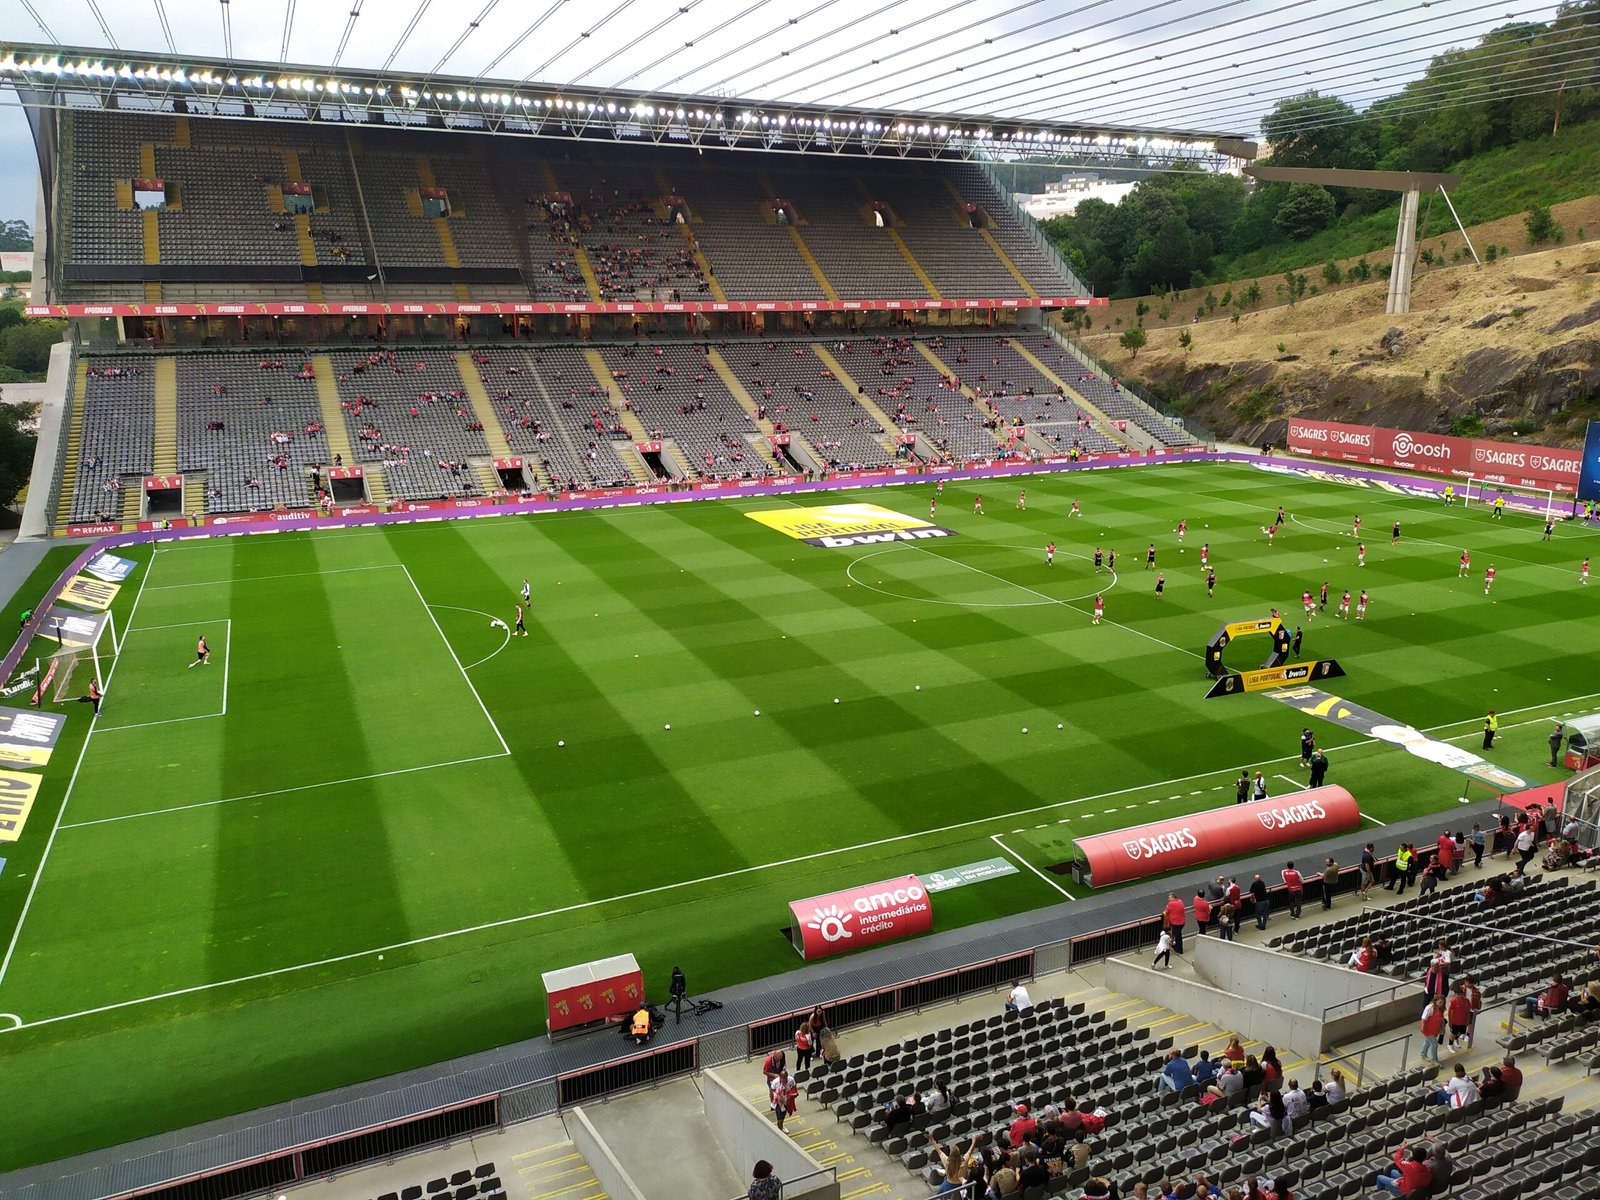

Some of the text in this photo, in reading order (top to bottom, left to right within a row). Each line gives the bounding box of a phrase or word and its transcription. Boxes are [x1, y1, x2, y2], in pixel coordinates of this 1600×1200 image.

[1298, 426, 1327, 442] SAGRES
[1339, 431, 1370, 447] SAGRES
[1486, 449, 1525, 468] SAGRES
[277, 512, 310, 521] auditiv
[82, 525, 114, 534] RE/MAX
[819, 529, 948, 548] bwin
[1288, 668, 1306, 678] bwin
[1272, 799, 1327, 829] SAGRES
[1140, 827, 1197, 859] SAGRES
[853, 885, 922, 913] amco
[859, 902, 927, 925] intermediários
[860, 920, 893, 935] crédito
